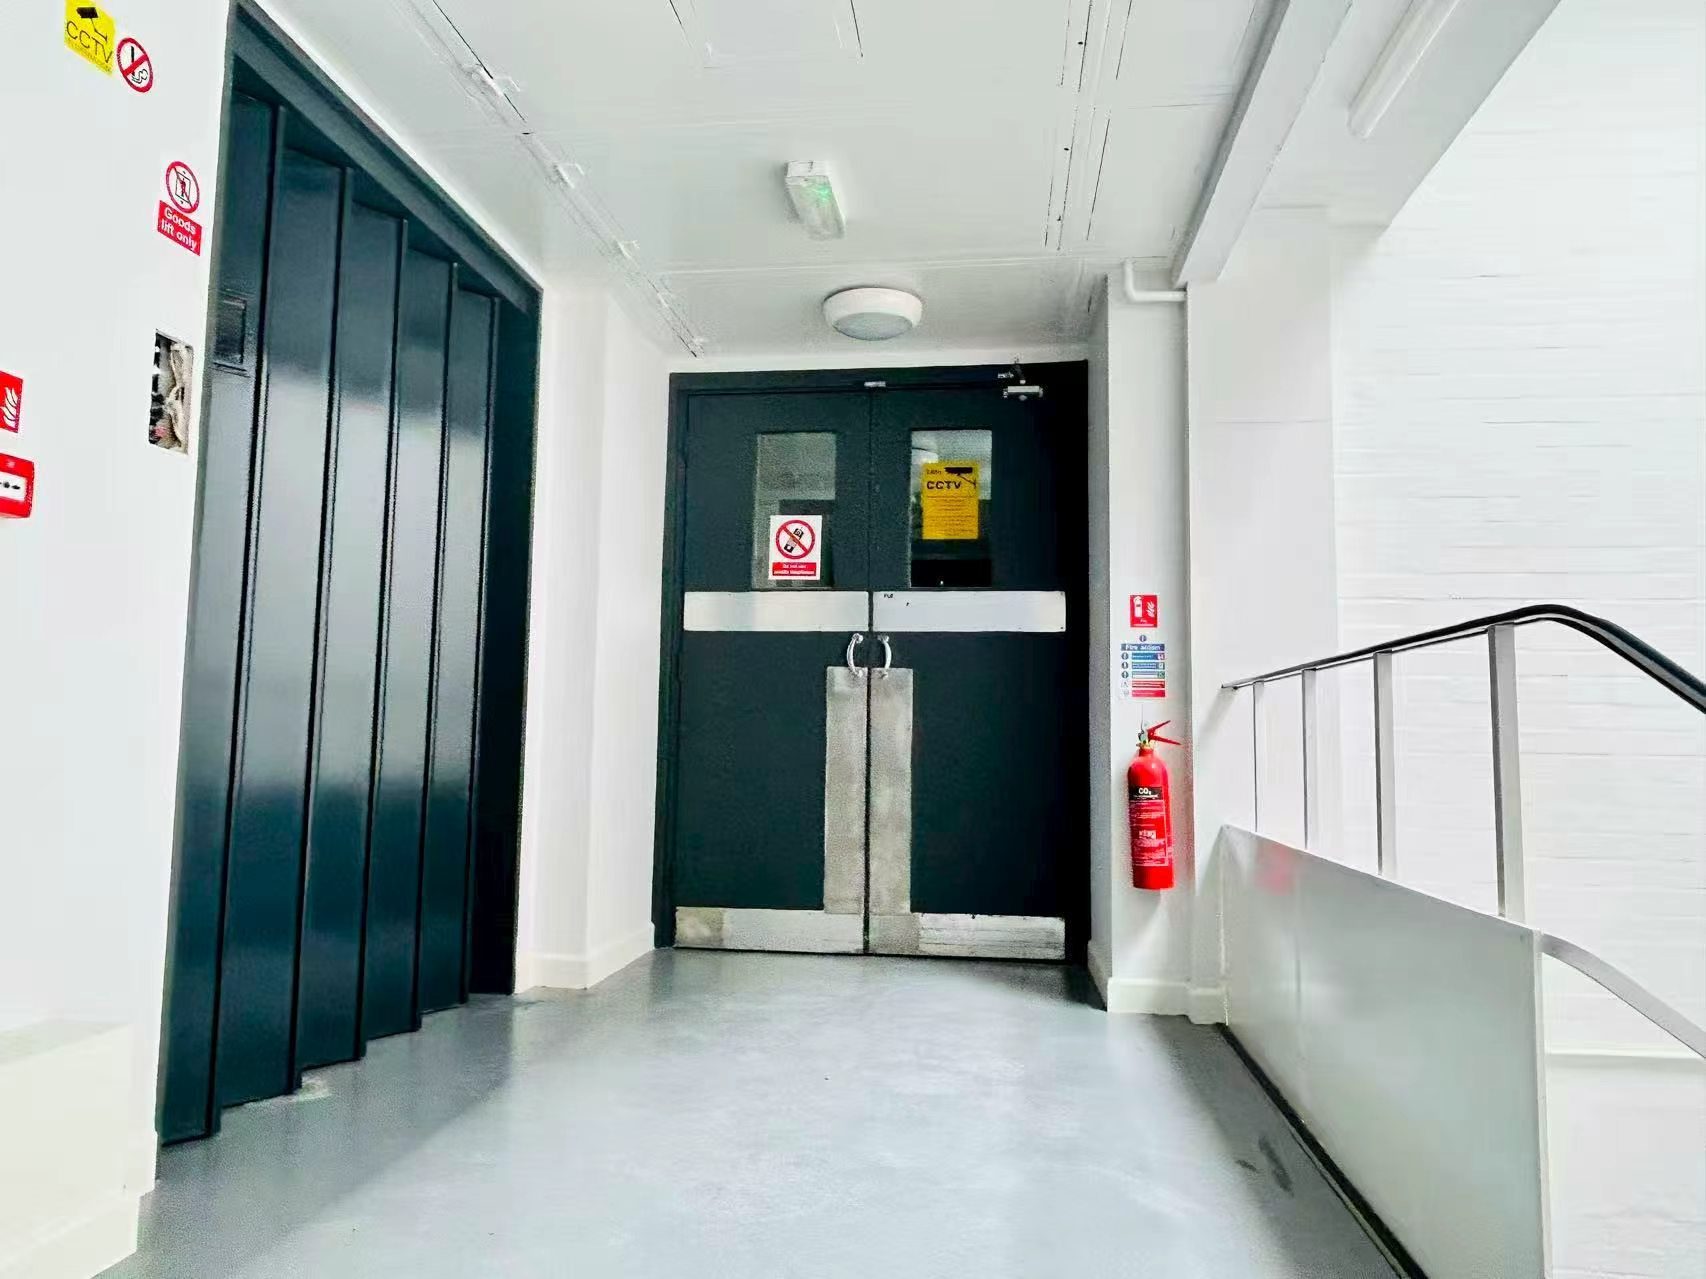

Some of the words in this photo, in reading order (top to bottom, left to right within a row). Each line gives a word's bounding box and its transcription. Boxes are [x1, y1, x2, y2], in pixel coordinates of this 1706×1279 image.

[66, 20, 113, 64] CCTV
[161, 218, 175, 236] lift
[176, 231, 198, 251] only
[164, 207, 196, 236] Goods
[926, 480, 962, 490] CCTV
